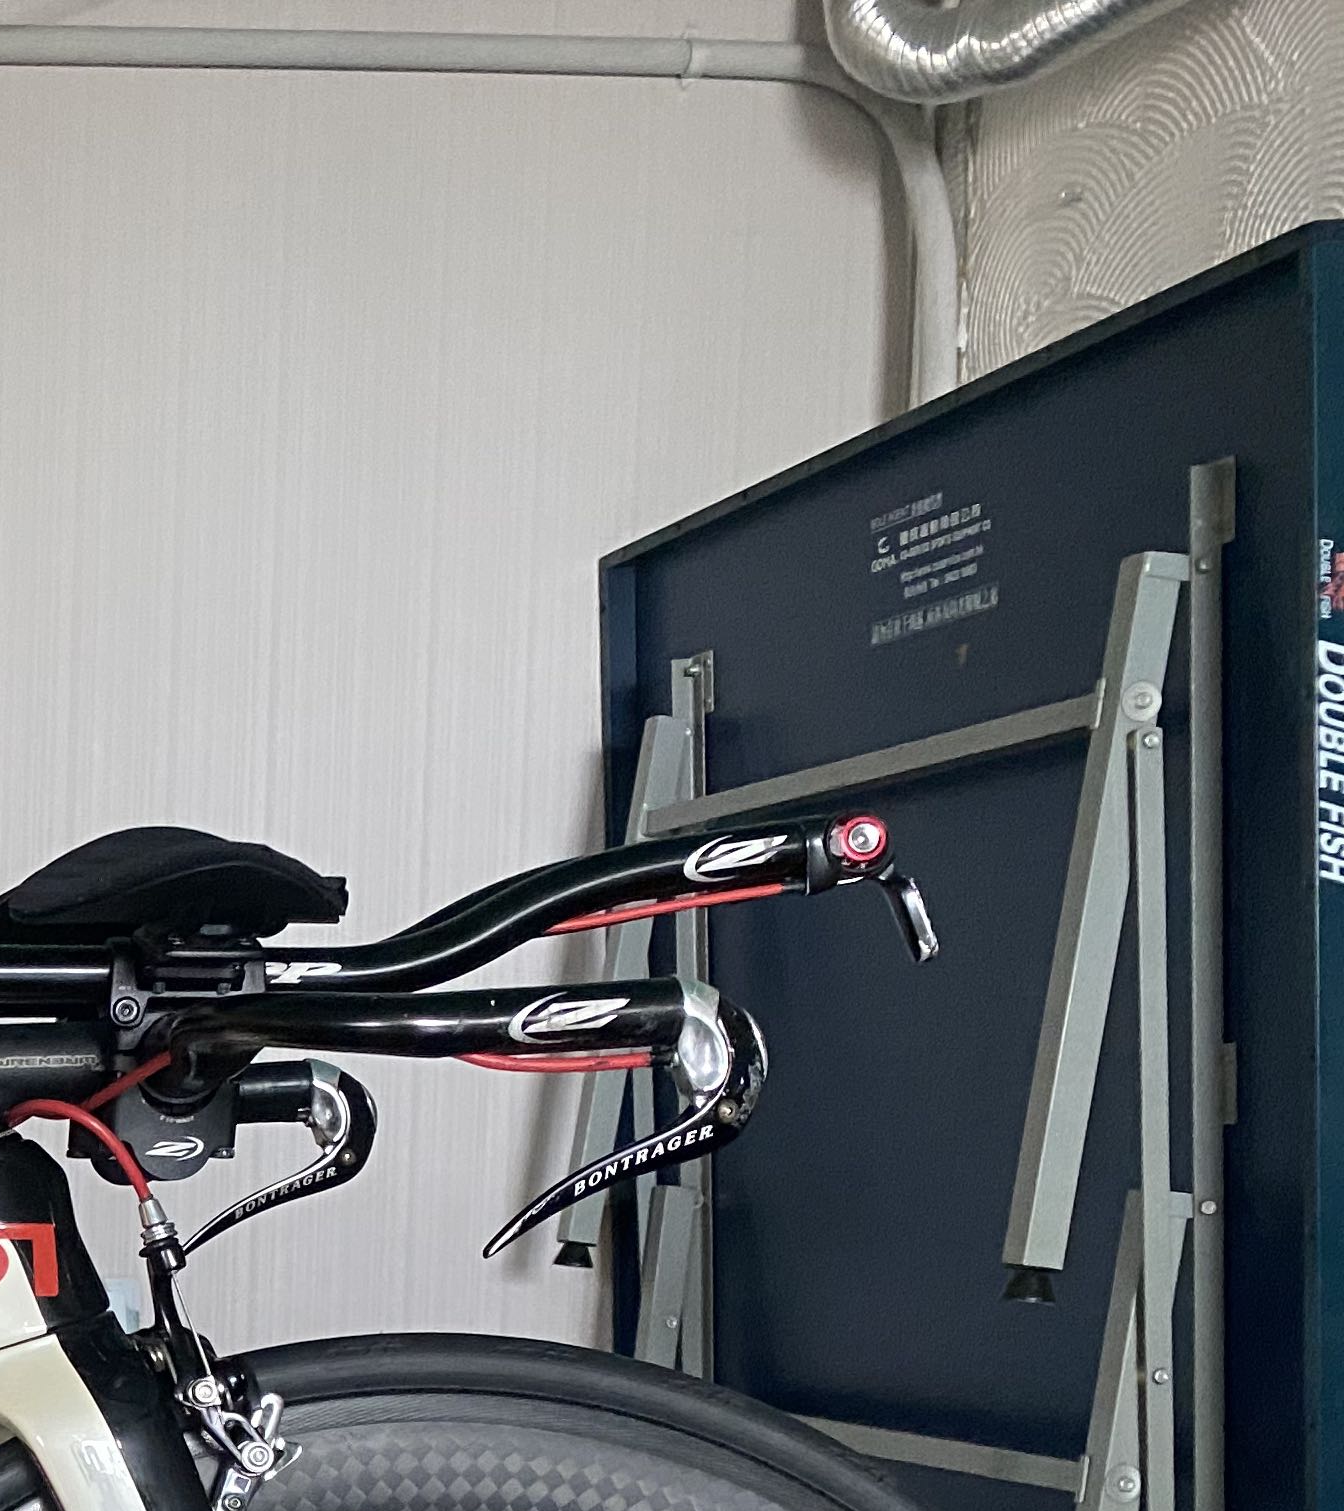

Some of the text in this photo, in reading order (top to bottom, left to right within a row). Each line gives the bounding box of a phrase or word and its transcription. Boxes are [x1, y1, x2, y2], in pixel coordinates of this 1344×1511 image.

[1318, 639, 1344, 790] DOUBLE
[234, 1166, 337, 1220] BONTRAGER
[573, 1123, 714, 1197] BONTRAGER
